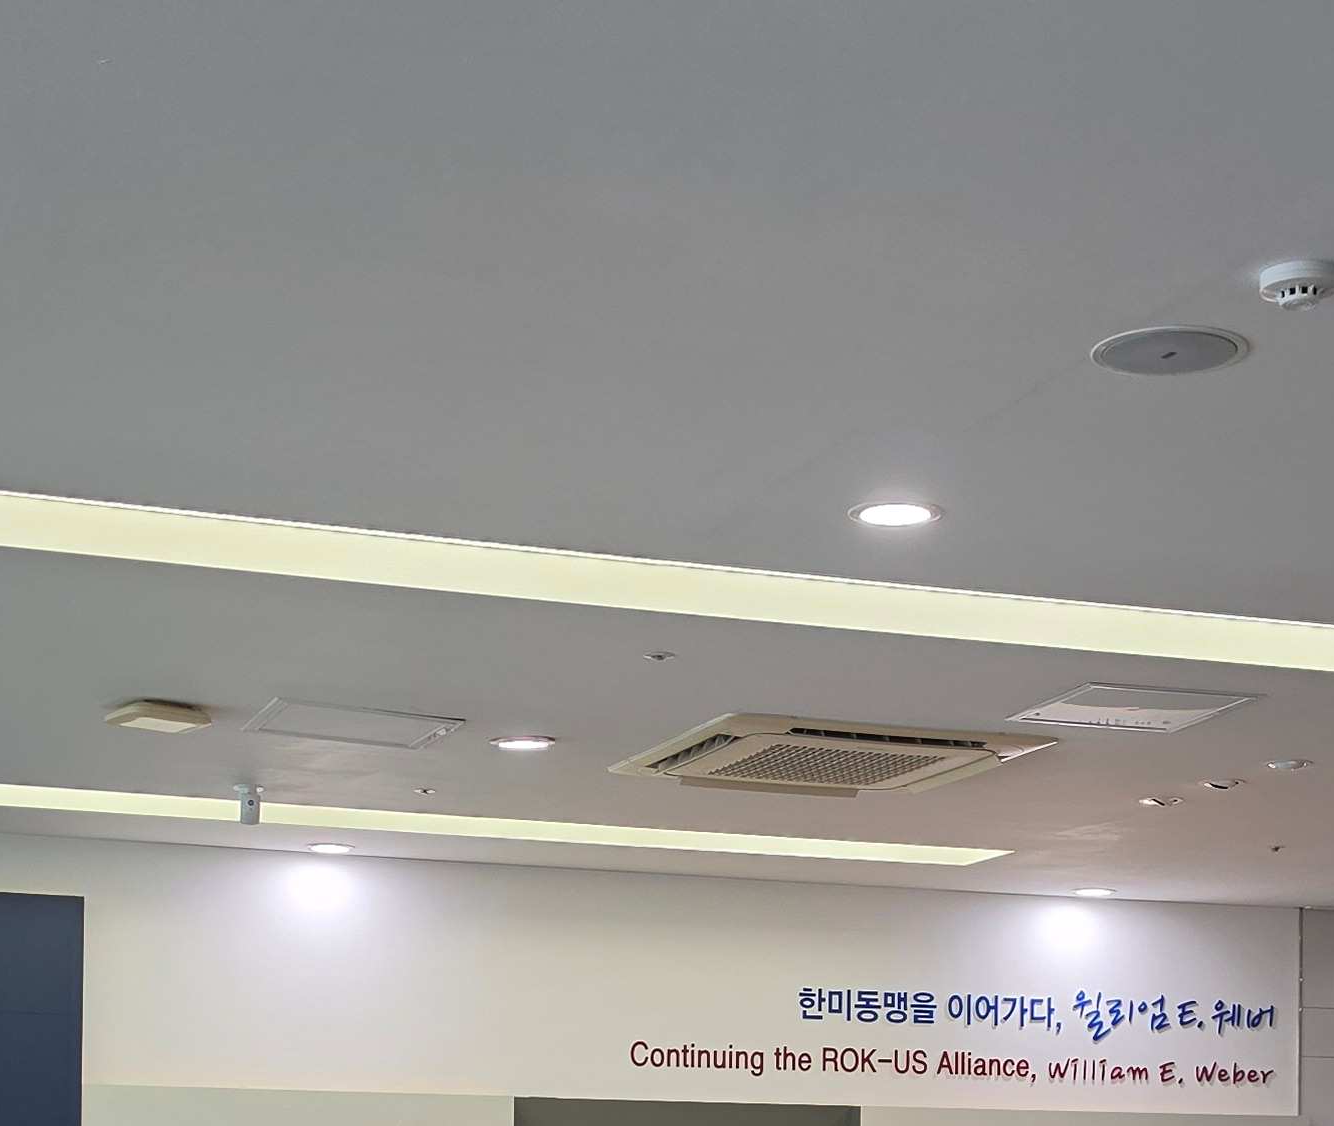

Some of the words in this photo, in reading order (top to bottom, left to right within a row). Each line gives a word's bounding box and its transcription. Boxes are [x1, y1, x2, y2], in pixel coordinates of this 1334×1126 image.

[799, 988, 937, 1024] 한미동맹을
[948, 994, 1062, 1034] 이어가다,
[1072, 990, 1170, 1041] 윌리엄
[1178, 1000, 1204, 1029] E.
[1211, 999, 1274, 1034] 웨버
[630, 1041, 764, 1077] Continuing
[774, 1046, 812, 1071] the
[822, 1047, 928, 1075] ROK-US
[937, 1051, 1037, 1083] Alliance,
[1048, 1057, 1149, 1081] William
[1160, 1061, 1184, 1084] E.
[1195, 1062, 1275, 1084] Weber
